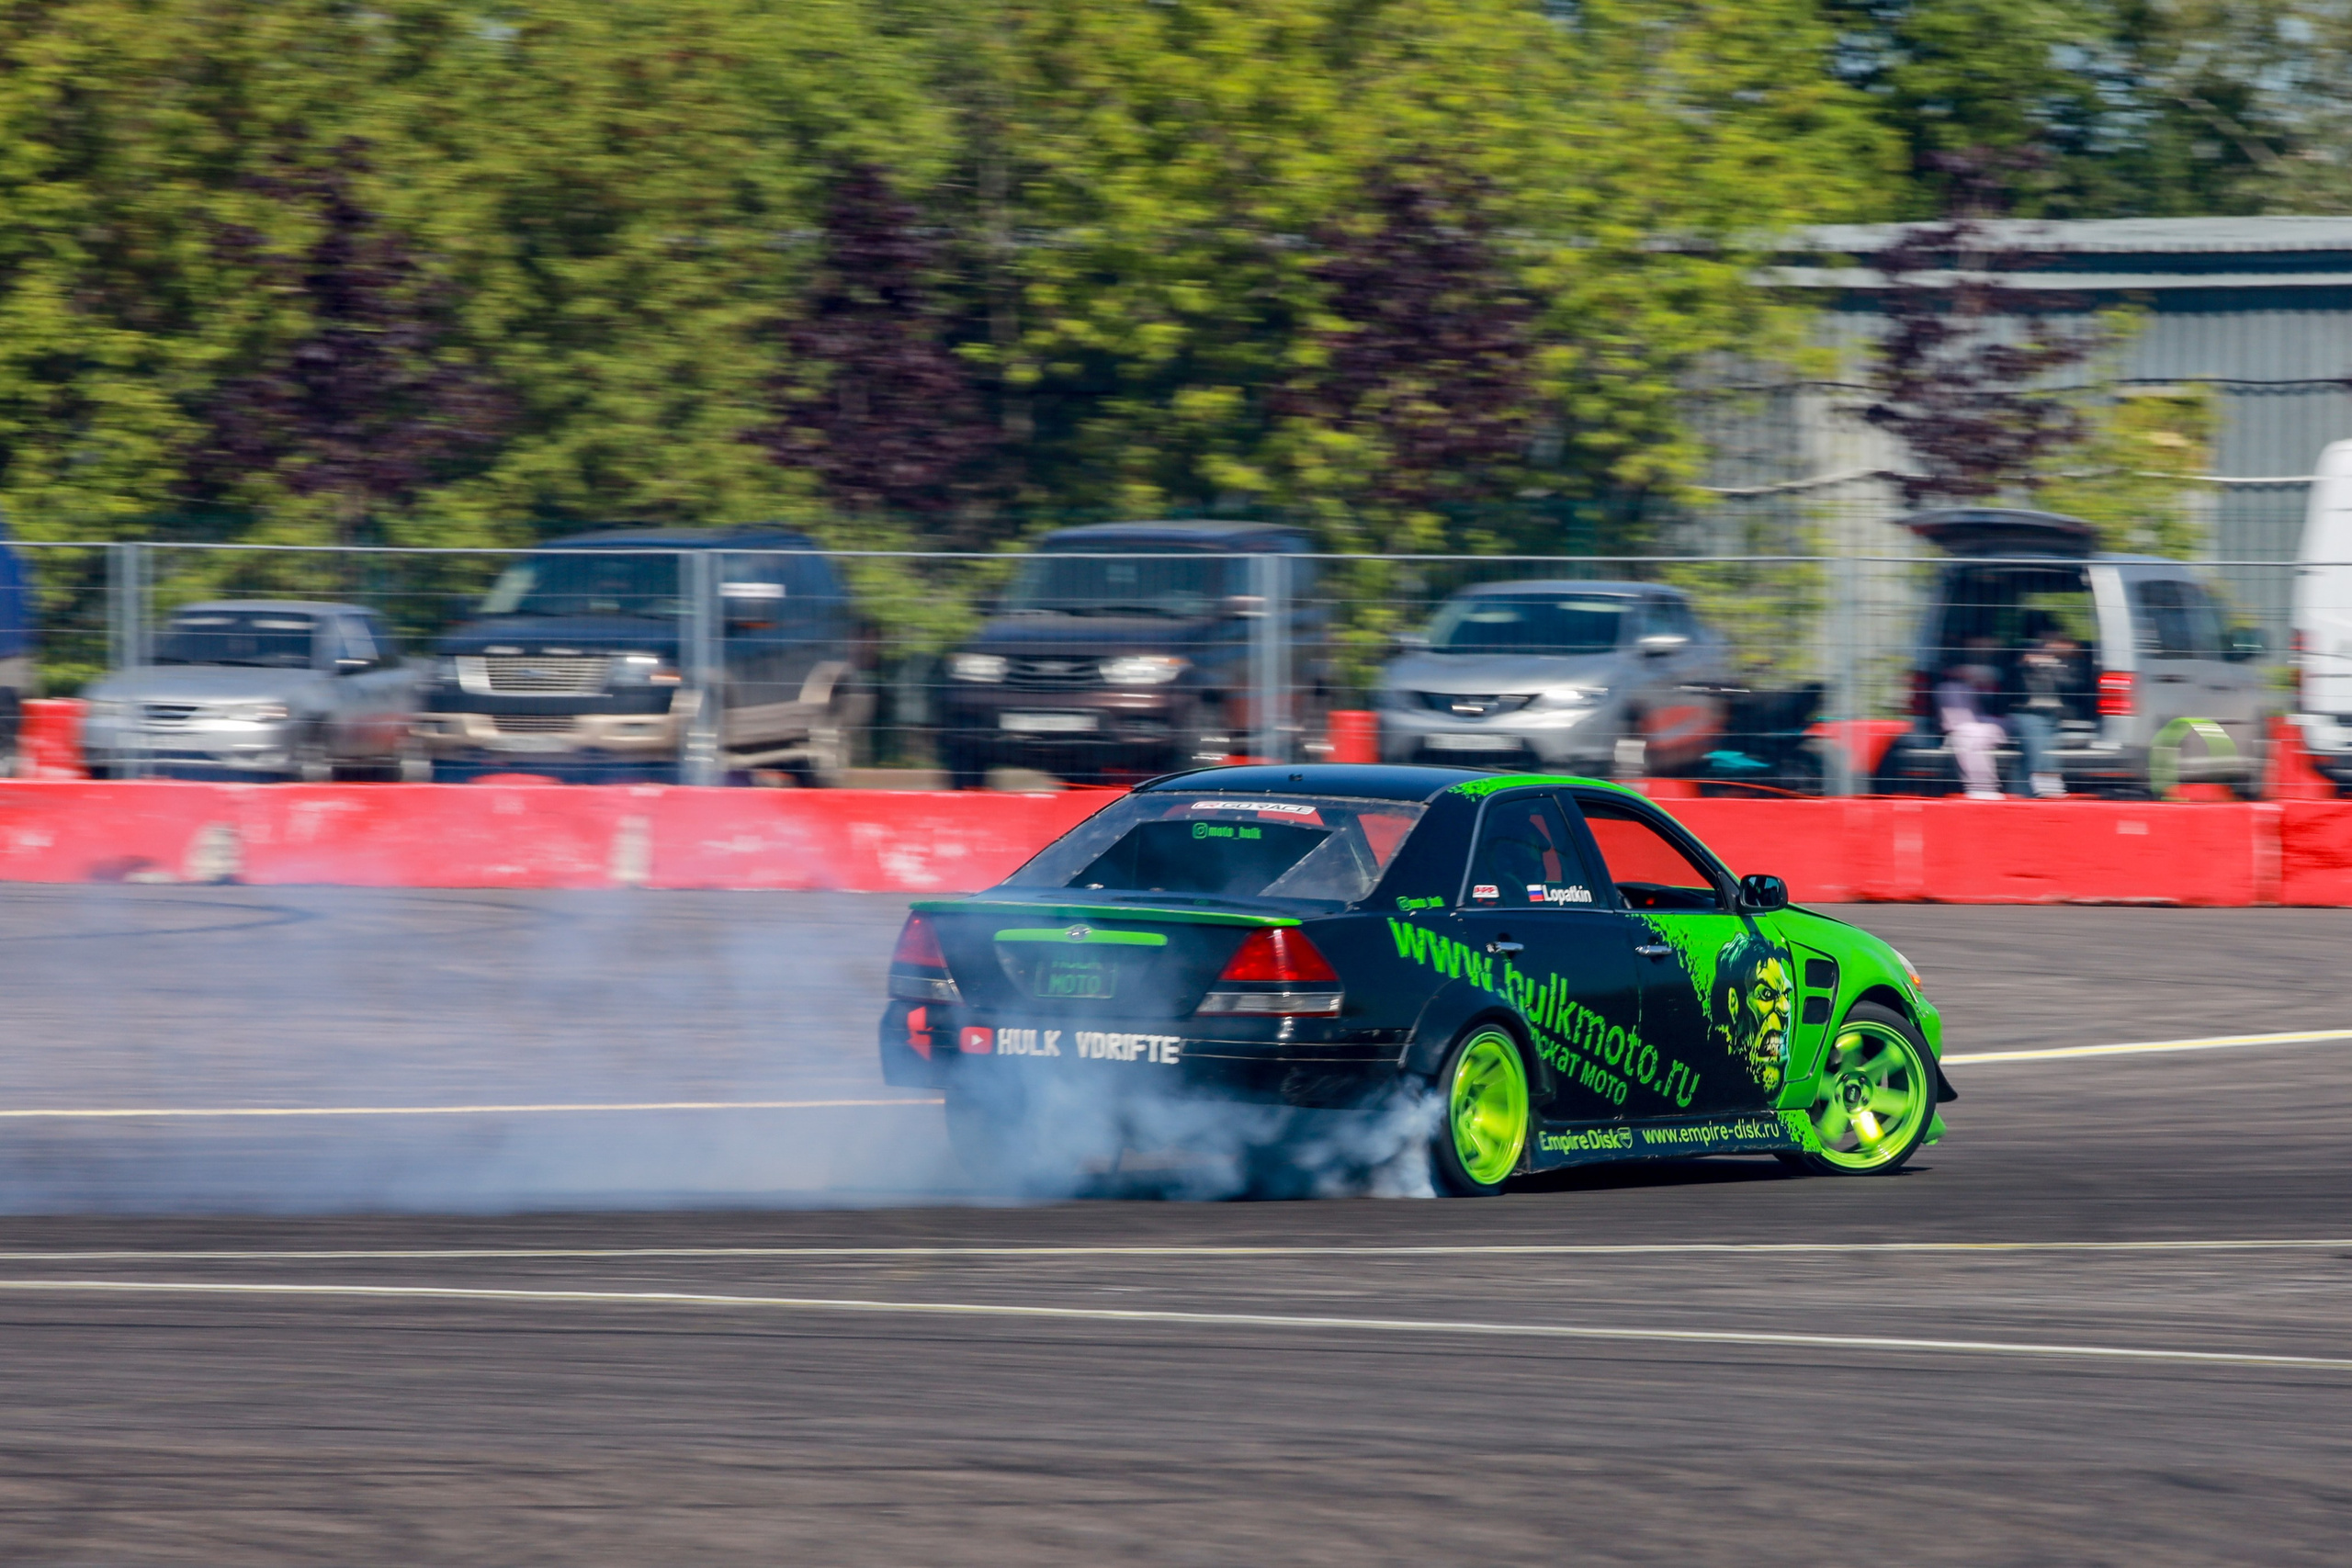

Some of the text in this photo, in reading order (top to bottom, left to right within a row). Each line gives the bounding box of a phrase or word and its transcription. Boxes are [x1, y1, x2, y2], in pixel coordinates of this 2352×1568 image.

[1543, 884, 1592, 906] Lopatkin
[1387, 917, 1701, 1108] www.hulkmoto.ru
[997, 1028, 1182, 1065] HULK VDRIFTE
[1539, 1118, 1780, 1156] EmpireDisk www.empire-disk.ru
